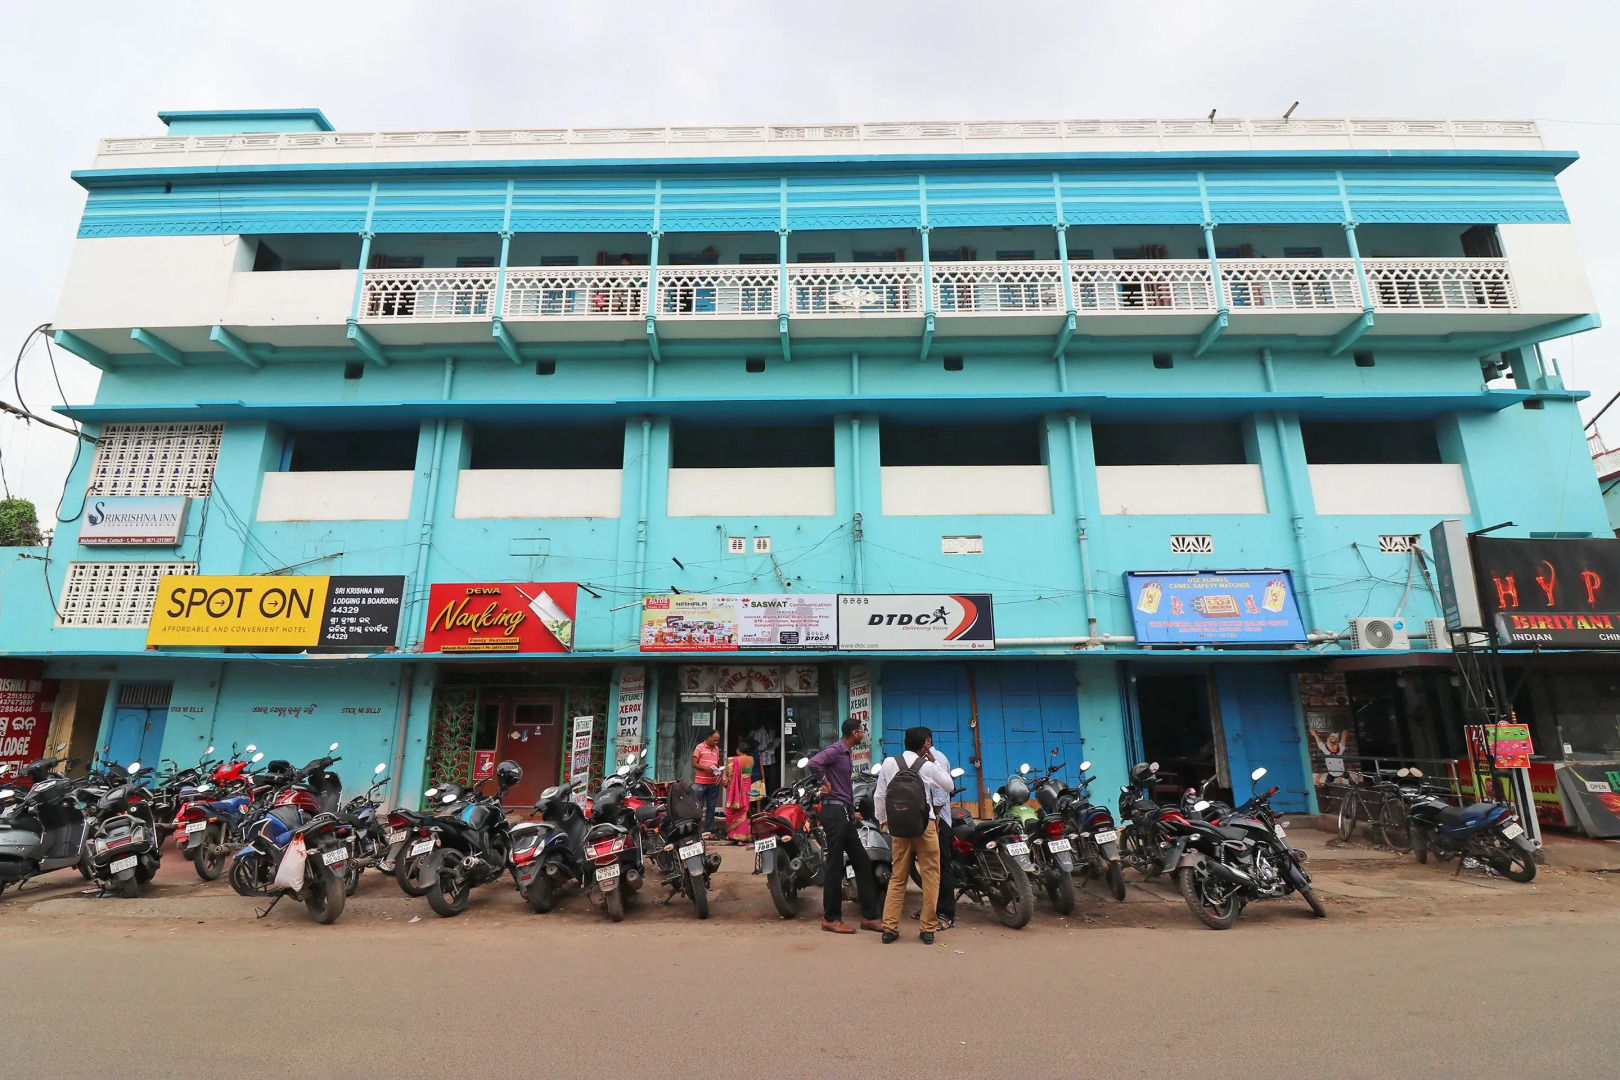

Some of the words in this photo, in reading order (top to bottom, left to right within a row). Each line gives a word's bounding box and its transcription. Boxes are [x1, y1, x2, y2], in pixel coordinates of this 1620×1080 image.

[160, 514, 177, 522] INN
[465, 587, 501, 595] DEWA
[166, 588, 253, 618] SPOT
[259, 588, 314, 618] ON
[430, 597, 526, 636] Nanking
[868, 614, 931, 626] DTDC
[1511, 615, 1615, 629] BIRIYANI
[1512, 633, 1553, 641] INDIAN
[725, 670, 774, 690] WELCOME
[619, 693, 643, 702] INTERNET
[619, 703, 642, 714] XEROX
[851, 698, 868, 710] XEROX
[341, 707, 356, 715] STICK
[620, 716, 638, 726] DTP
[621, 728, 637, 738] FAX
[623, 744, 639, 754] SCAN
